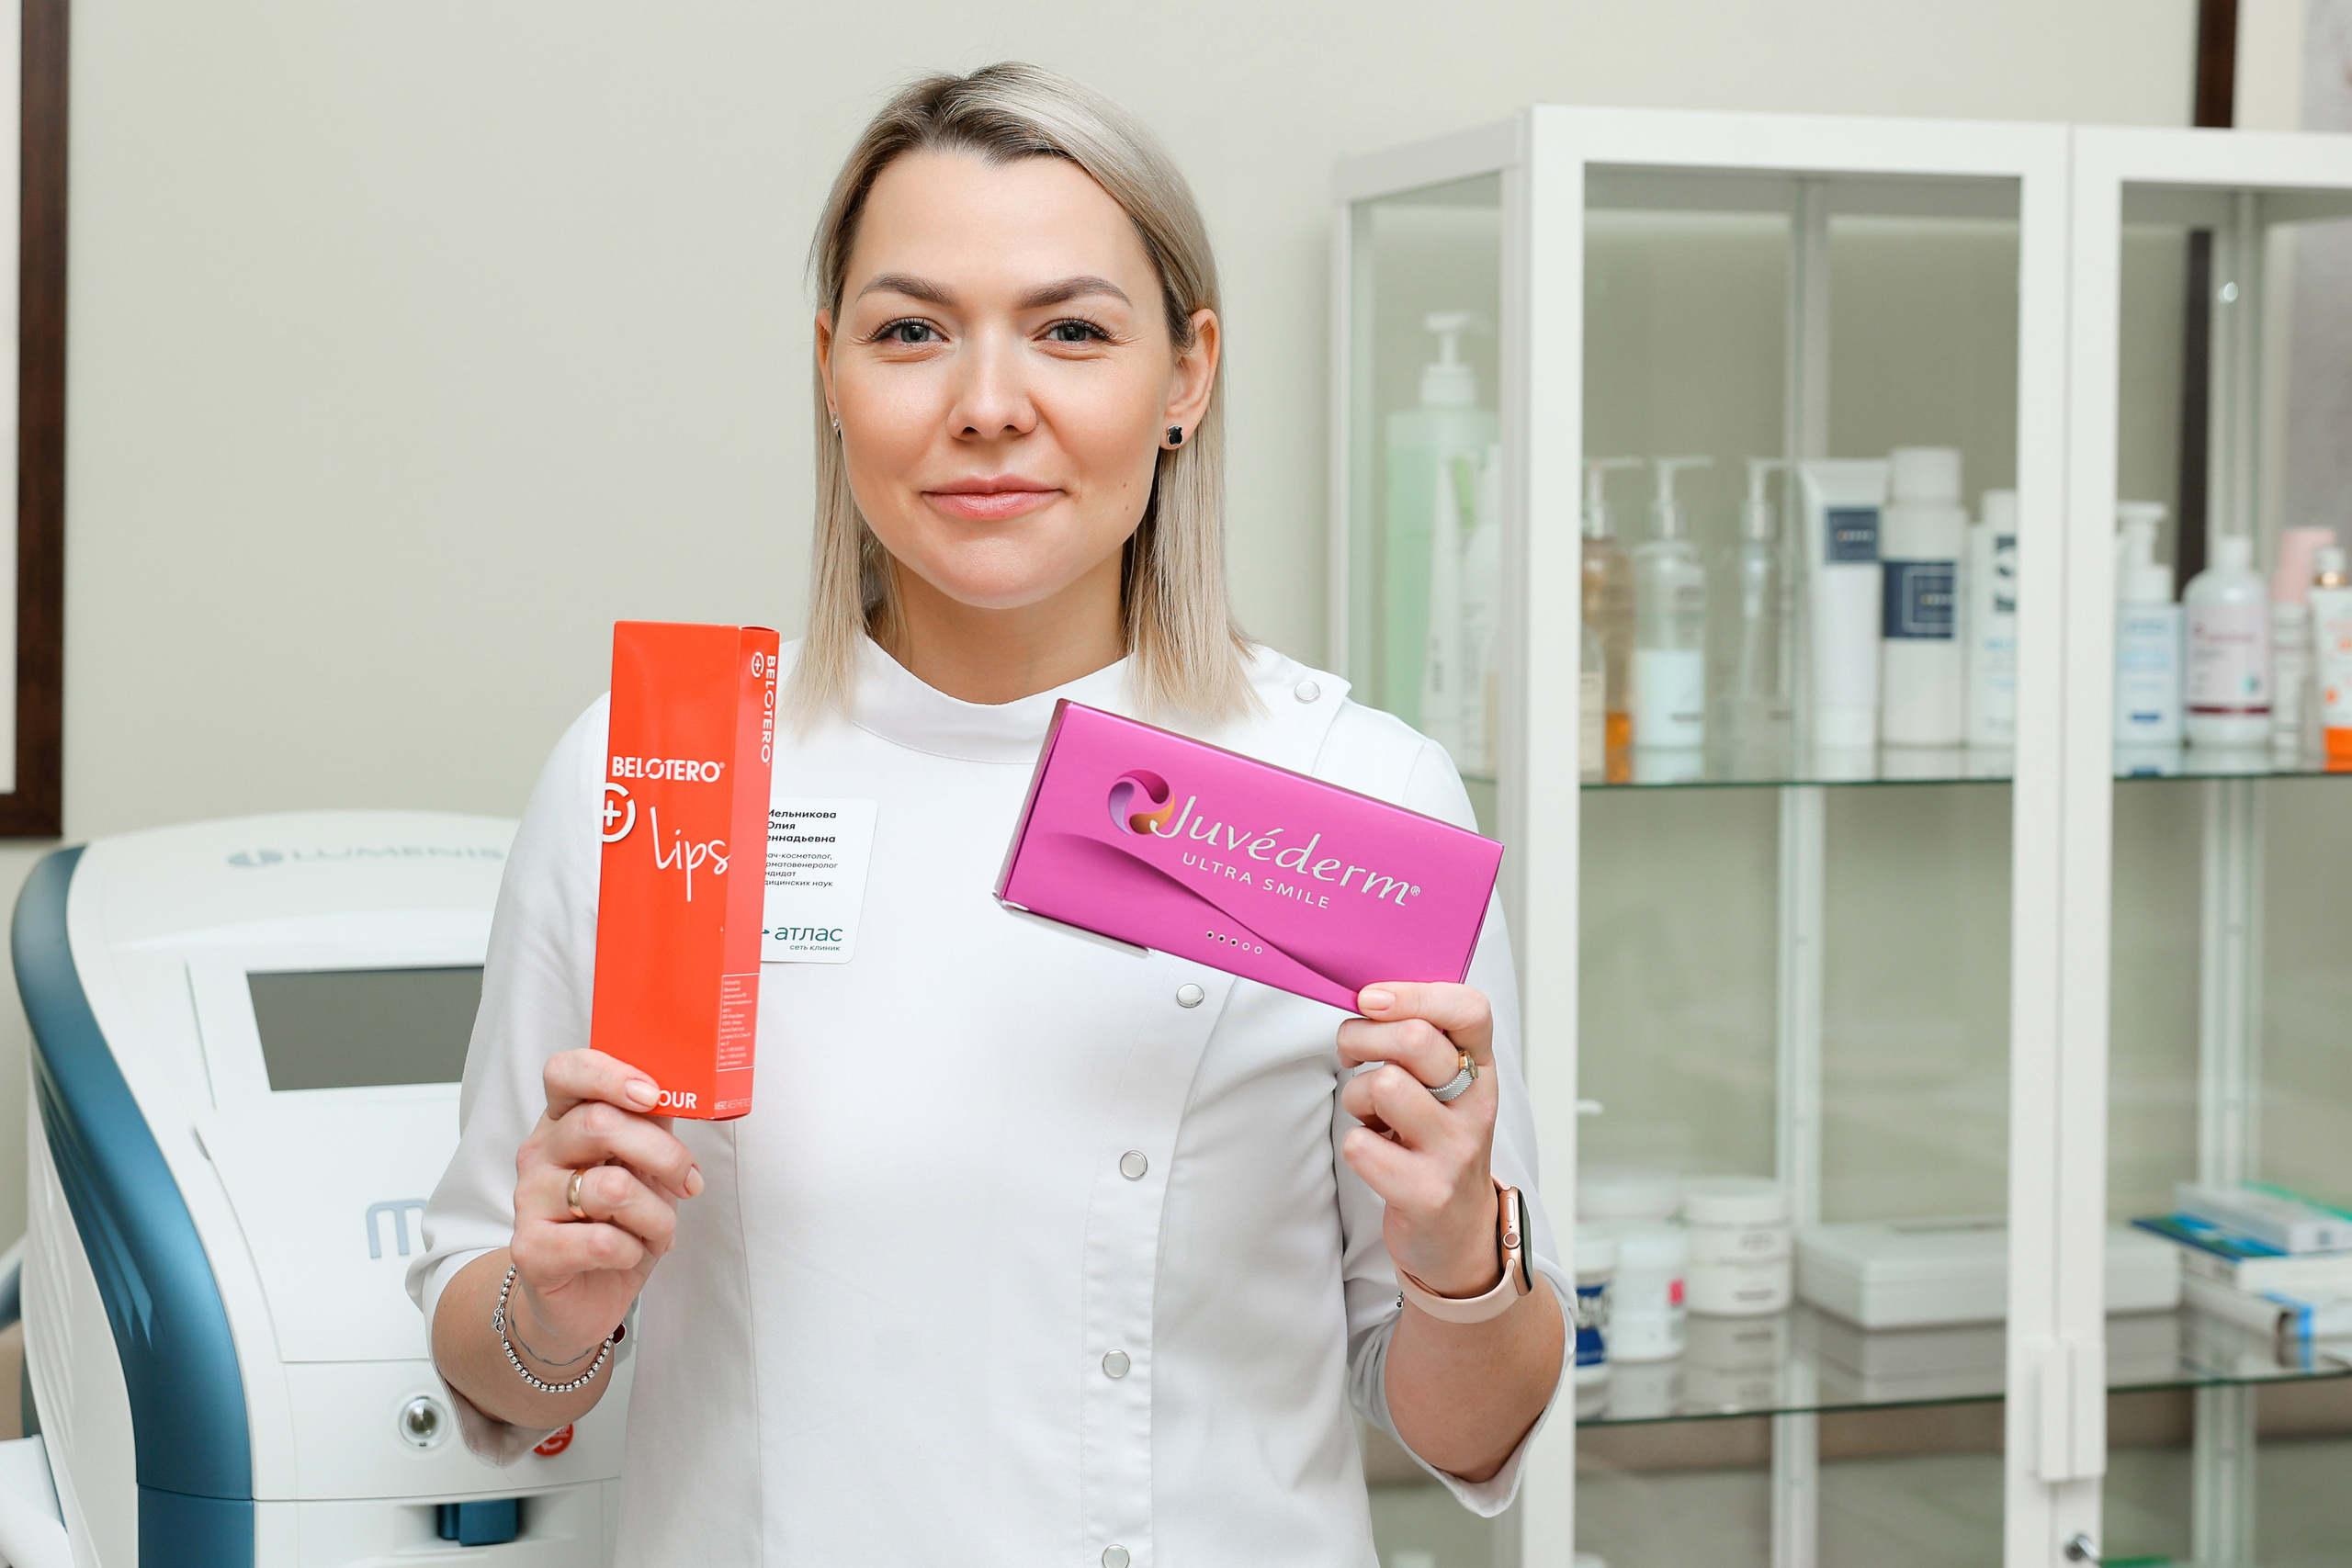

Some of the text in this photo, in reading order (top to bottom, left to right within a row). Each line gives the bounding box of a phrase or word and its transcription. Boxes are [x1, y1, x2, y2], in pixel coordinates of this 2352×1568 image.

[761, 654, 777, 763] BELOTERO
[766, 834, 836, 843] еннадьевна
[765, 852, 832, 861] ач-косметолог,
[764, 861, 839, 870] рматовенеролог
[764, 870, 797, 878] ндидат
[763, 879, 810, 887] дицинских
[1182, 852, 1331, 909] ULTRA SMILE
[775, 926, 843, 942] атлас
[659, 1089, 697, 1110] OUR
